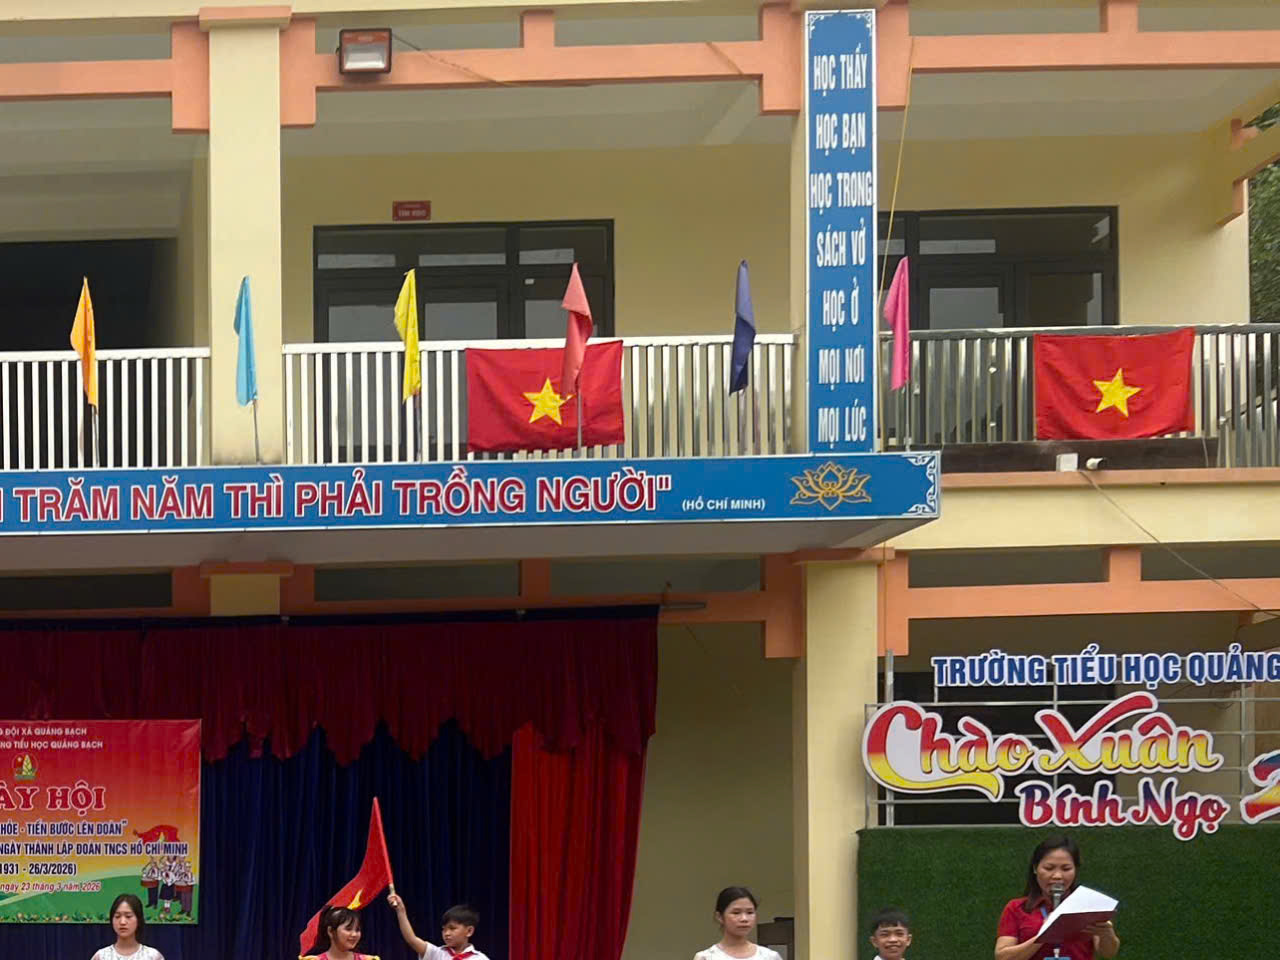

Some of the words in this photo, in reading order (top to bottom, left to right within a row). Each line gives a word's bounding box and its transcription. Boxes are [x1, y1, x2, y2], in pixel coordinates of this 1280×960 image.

[814, 54, 836, 96] HỌC
[816, 113, 838, 156] HỌC
[842, 112, 866, 155] BẠN
[810, 172, 832, 215] HỌC
[836, 171, 873, 208] TRONG
[816, 224, 846, 268] SÁCH
[851, 217, 866, 266] VỞ
[823, 290, 845, 332] HỌC
[850, 276, 860, 326] Ở
[818, 348, 840, 391] MỌI
[845, 344, 865, 384] NƠI
[818, 407, 840, 449] MỌI
[845, 399, 866, 442] LÚC
[12, 477, 120, 522] TRĂM
[130, 475, 214, 520] NĂM
[224, 472, 283, 518] THÌ
[294, 467, 382, 517] PHẢI
[392, 464, 526, 516] TRỒNG
[536, 466, 672, 513] NGƯỜI"
[706, 496, 728, 510] CHÍ
[730, 498, 766, 512] MINH)
[932, 649, 1046, 687] TRƯỜNG
[1052, 644, 1117, 686] TIỂU
[1124, 654, 1181, 690] HỌC
[30, 740, 48, 750] HỌC
[81, 740, 103, 750] BẠCH
[64, 728, 87, 738] BẠCH
[862, 700, 1036, 802] Chào
[1034, 691, 1224, 775] Xuân
[46, 779, 106, 817] HỘI
[1016, 779, 1132, 828] Bính
[1131, 777, 1230, 841] Ngọ
[24, 840, 54, 856] THÀNH
[56, 840, 74, 858] LẬP
[76, 840, 101, 856] ĐOÀN
[104, 842, 128, 856] TNCS
[145, 841, 161, 856] CHÍ
[163, 842, 188, 856] MINH
[26, 820, 47, 836] TIẾN
[50, 820, 74, 836] BƯỚC
[76, 820, 94, 836] LÊN
[0, 882, 19, 894] ngày
[21, 882, 31, 891] 23
[32, 882, 55, 893] tháng
[82, 882, 101, 891] 2026
[28, 863, 77, 876] 26/3/2026)
